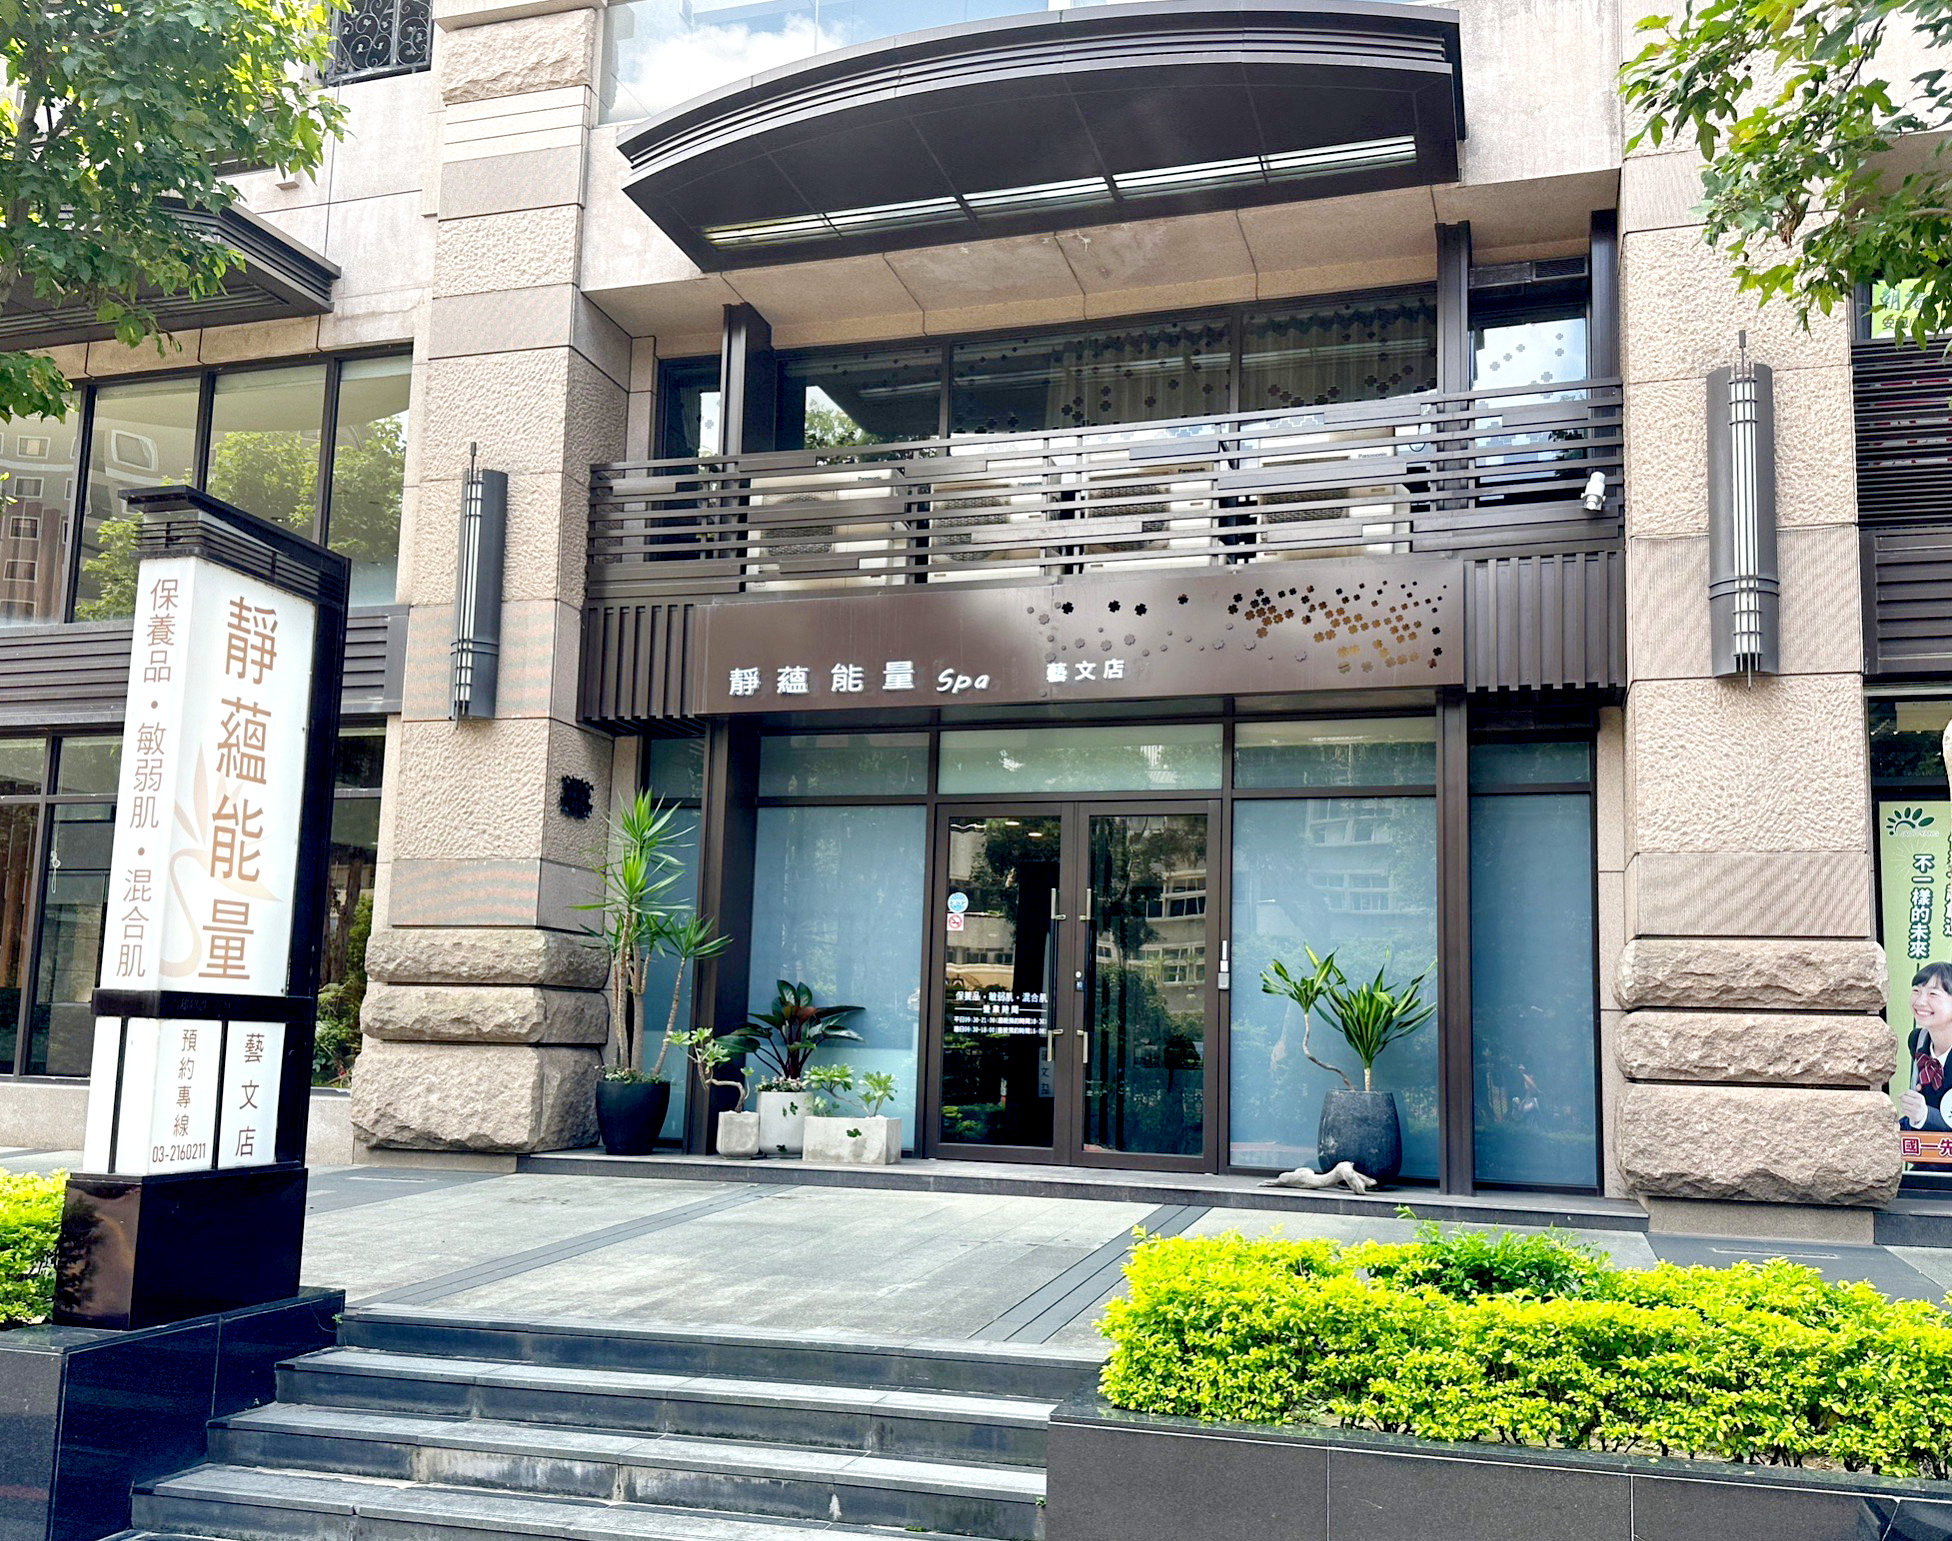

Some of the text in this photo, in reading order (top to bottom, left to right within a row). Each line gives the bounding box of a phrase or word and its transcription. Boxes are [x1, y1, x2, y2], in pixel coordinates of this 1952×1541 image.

[729, 660, 991, 697] 靜蘊能量 Spa
[1046, 658, 1125, 682] 藝文店
[198, 596, 279, 980] 靜蘊能量
[1908, 854, 1935, 960] 不一樣的未來
[172, 1029, 198, 1138] 預約專線
[235, 1033, 265, 1157] 藝文店
[152, 1142, 206, 1163] 03-2160211
